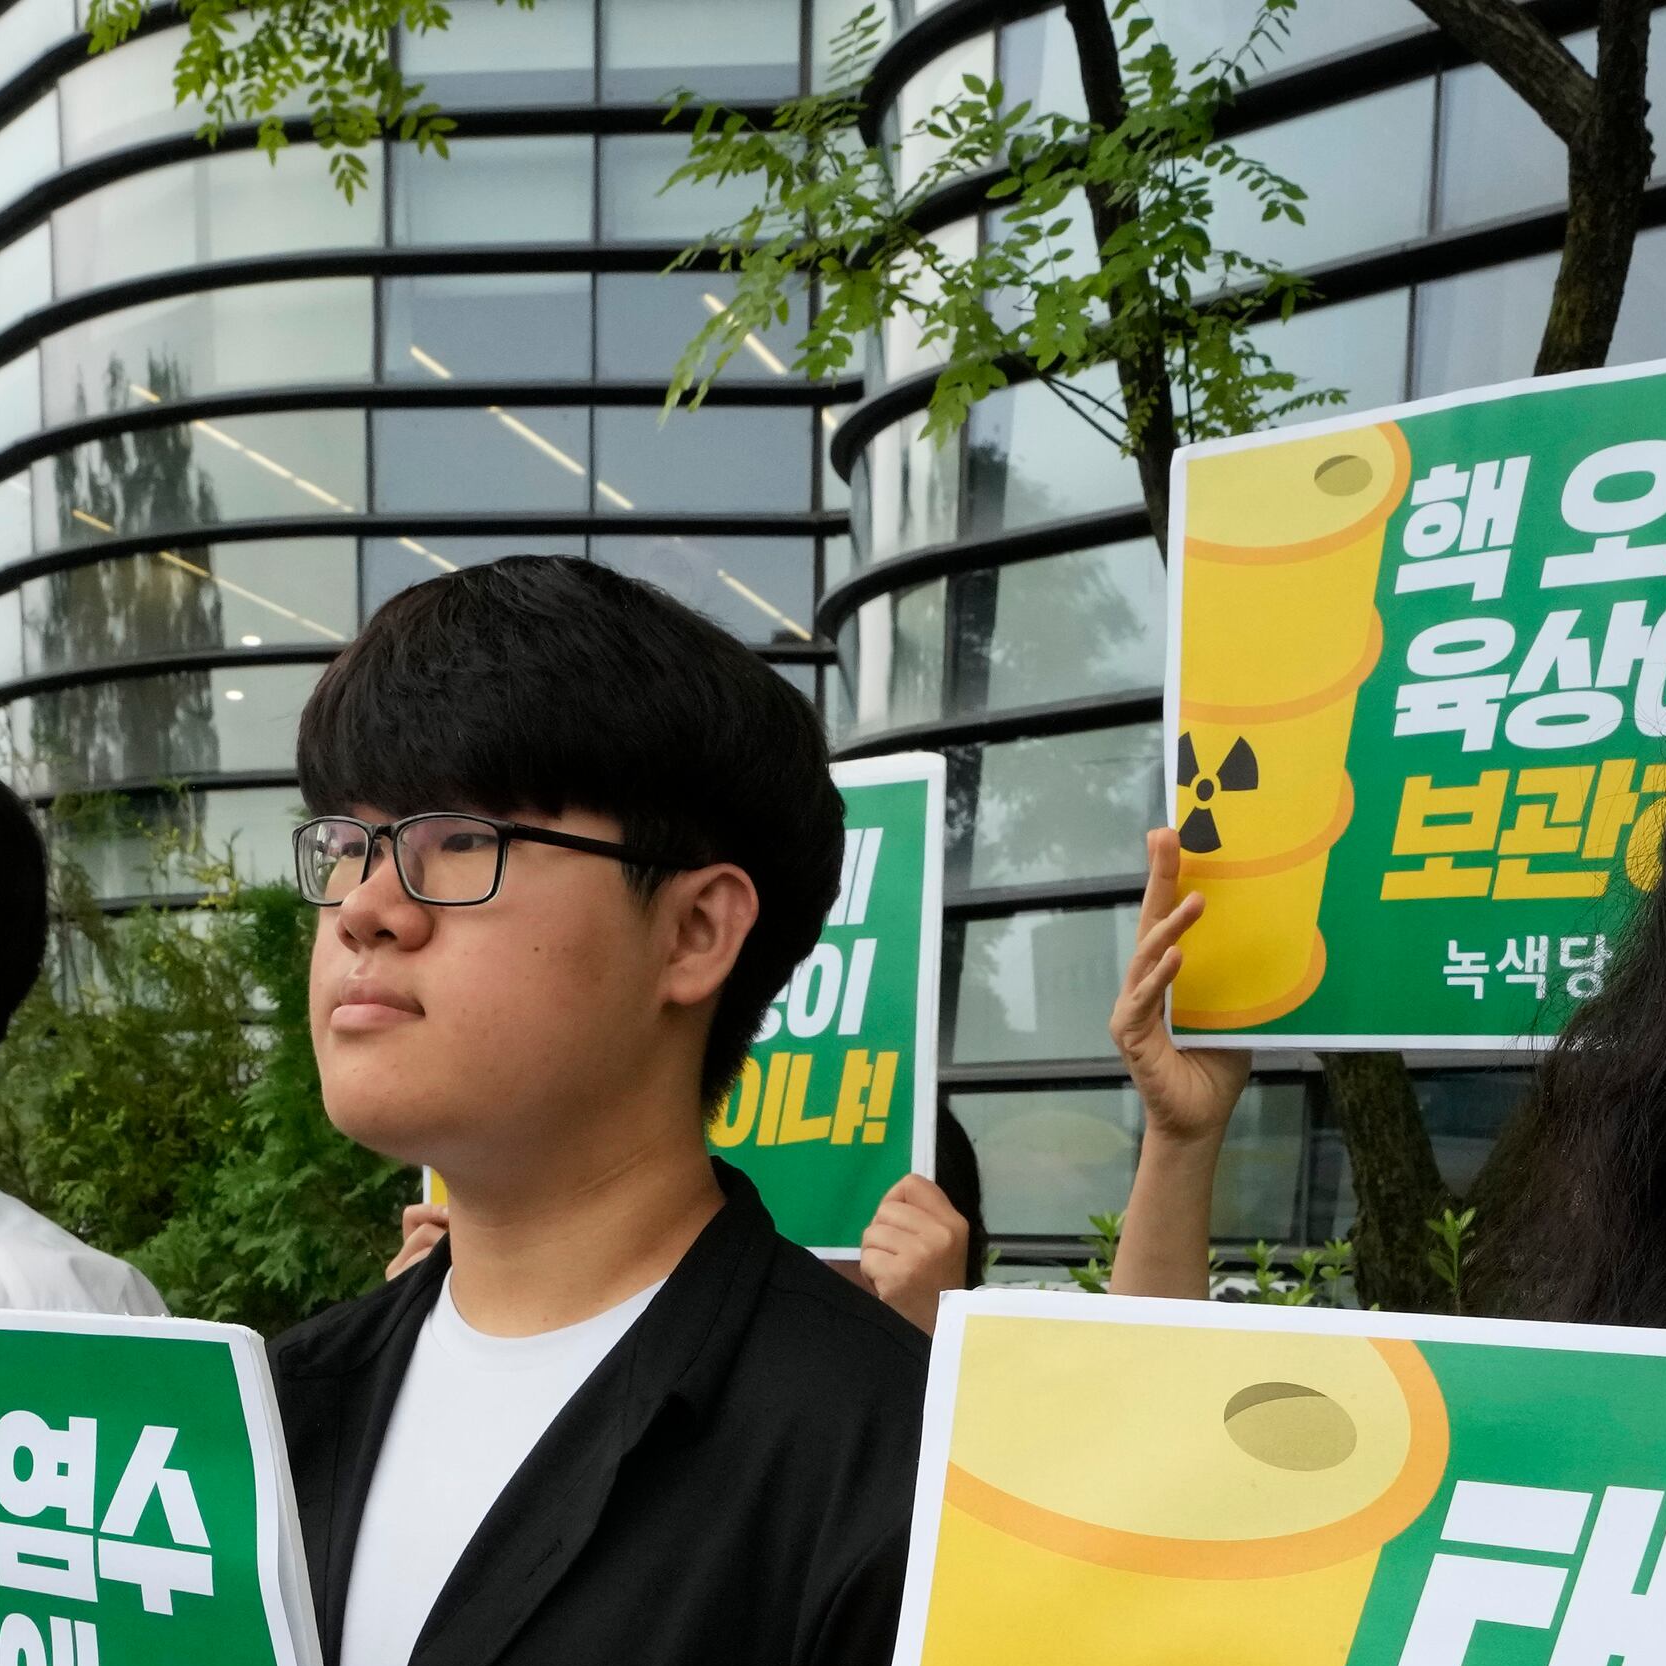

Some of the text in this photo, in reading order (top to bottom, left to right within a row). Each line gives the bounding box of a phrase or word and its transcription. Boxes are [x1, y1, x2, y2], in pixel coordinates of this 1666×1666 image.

[1394, 455, 1532, 602] 핵
[1443, 933, 1615, 1001] 녹색당
[706, 1049, 899, 1147] 이냐!
